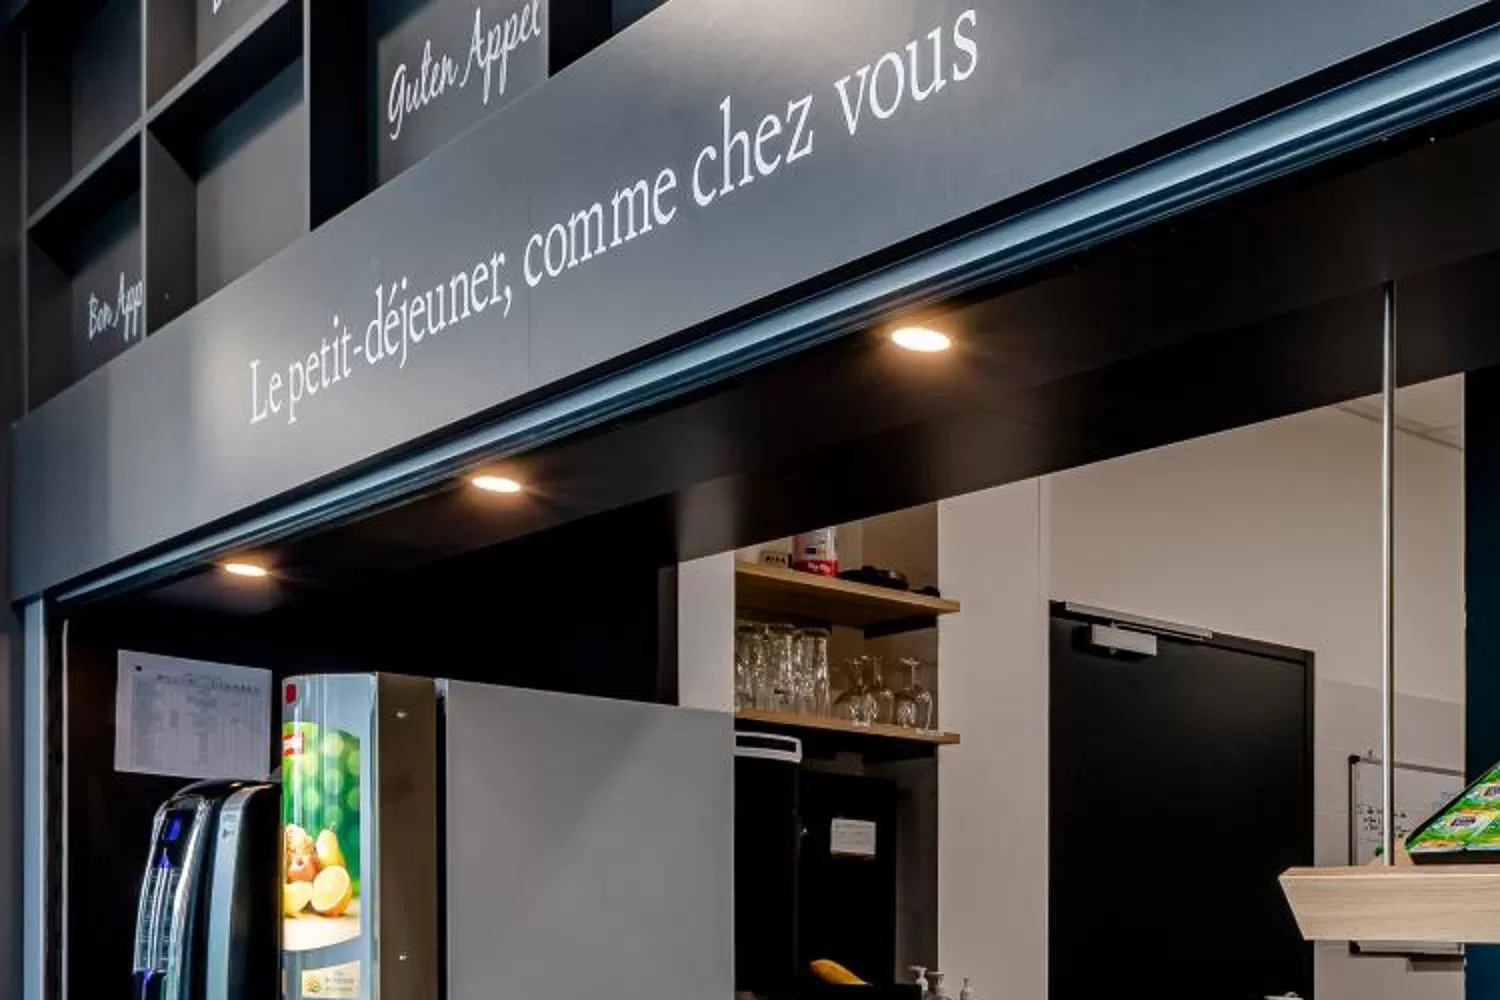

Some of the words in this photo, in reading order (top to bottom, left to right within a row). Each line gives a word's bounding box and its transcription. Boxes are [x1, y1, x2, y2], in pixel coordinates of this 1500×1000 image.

[250, 359, 281, 424] Le
[287, 253, 512, 424] petit-déjeuner,
[524, 168, 677, 287] comme
[692, 96, 814, 206] chez
[834, 9, 978, 136] vous
[387, 40, 458, 140] Guten
